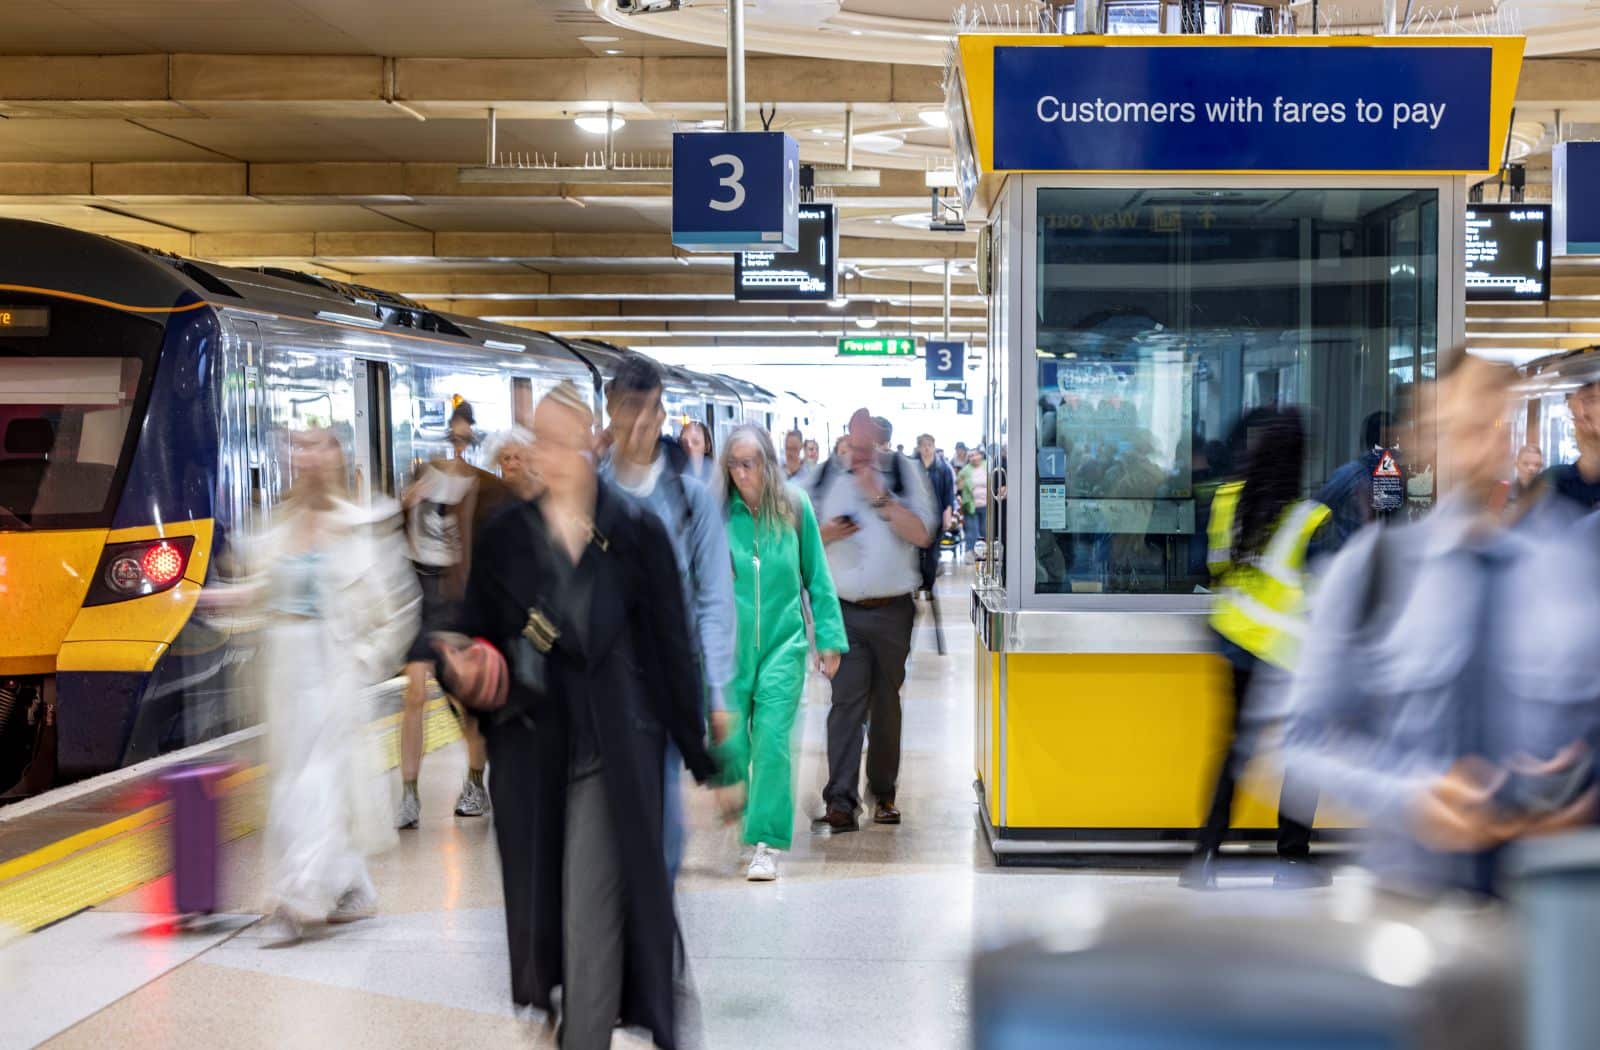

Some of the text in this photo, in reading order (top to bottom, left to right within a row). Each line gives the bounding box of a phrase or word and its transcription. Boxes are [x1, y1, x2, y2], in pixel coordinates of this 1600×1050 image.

[1036, 95, 1447, 129] Customers with fares to pay
[708, 153, 746, 211] 3
[937, 348, 952, 371] 3
[1046, 453, 1056, 476] 1
